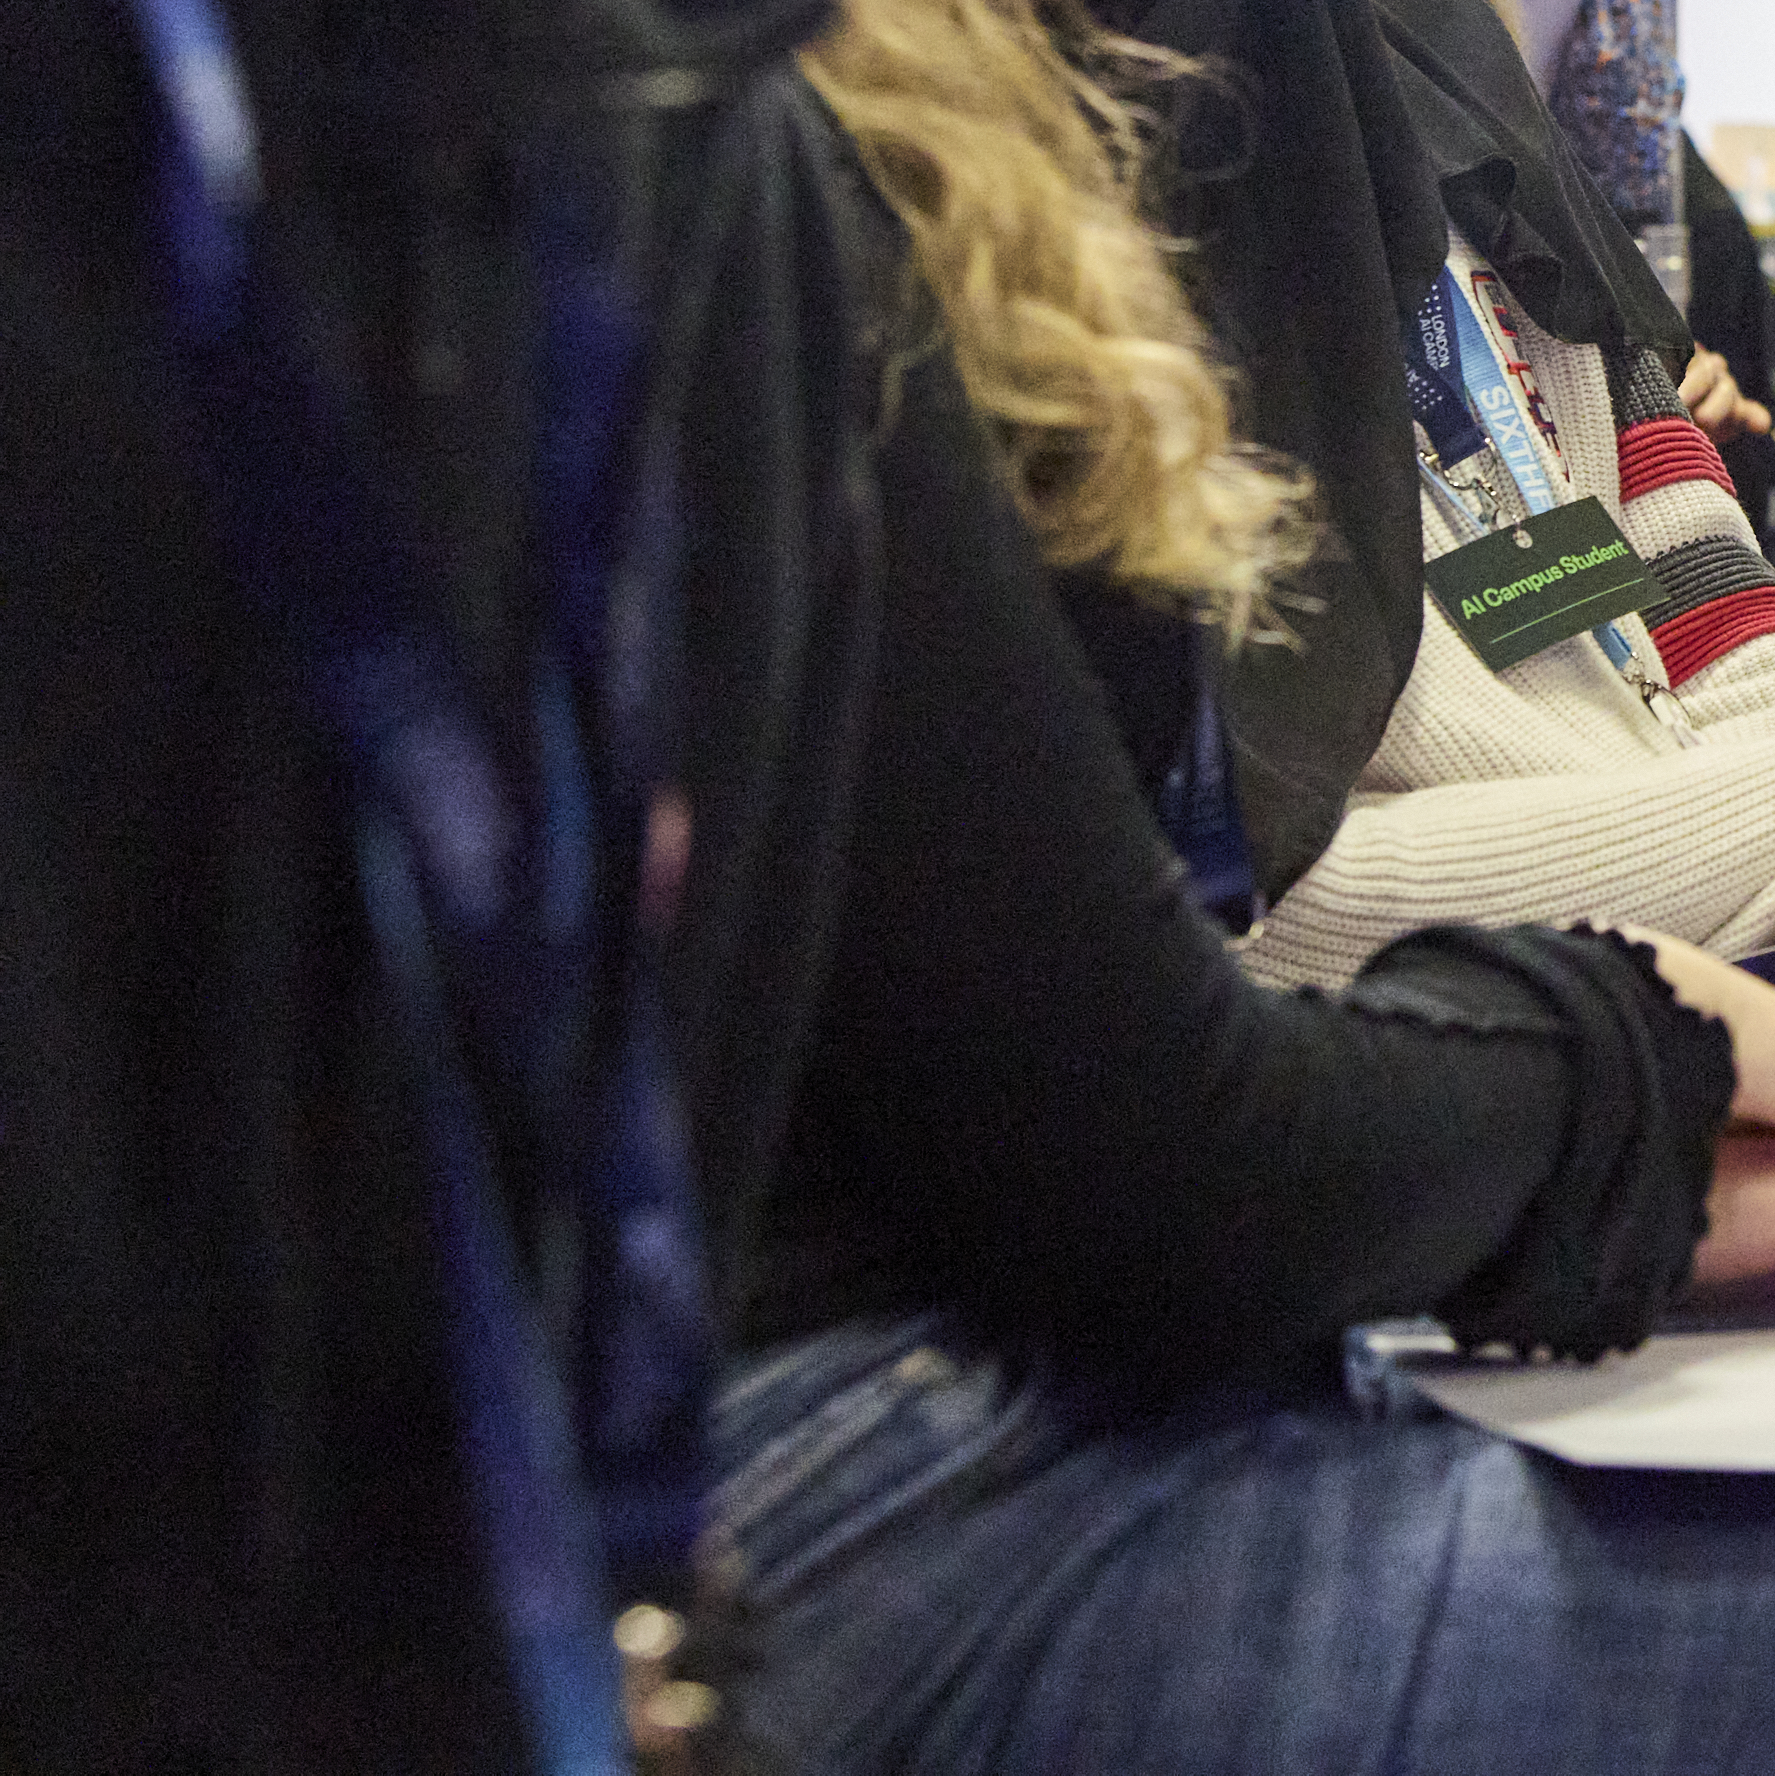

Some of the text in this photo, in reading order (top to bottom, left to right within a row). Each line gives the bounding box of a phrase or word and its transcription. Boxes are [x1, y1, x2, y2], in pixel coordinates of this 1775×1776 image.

[1419, 318, 1439, 370] AI CAMP
[1431, 314, 1450, 368] LONDON
[1461, 539, 1629, 620] AI Campus Student
